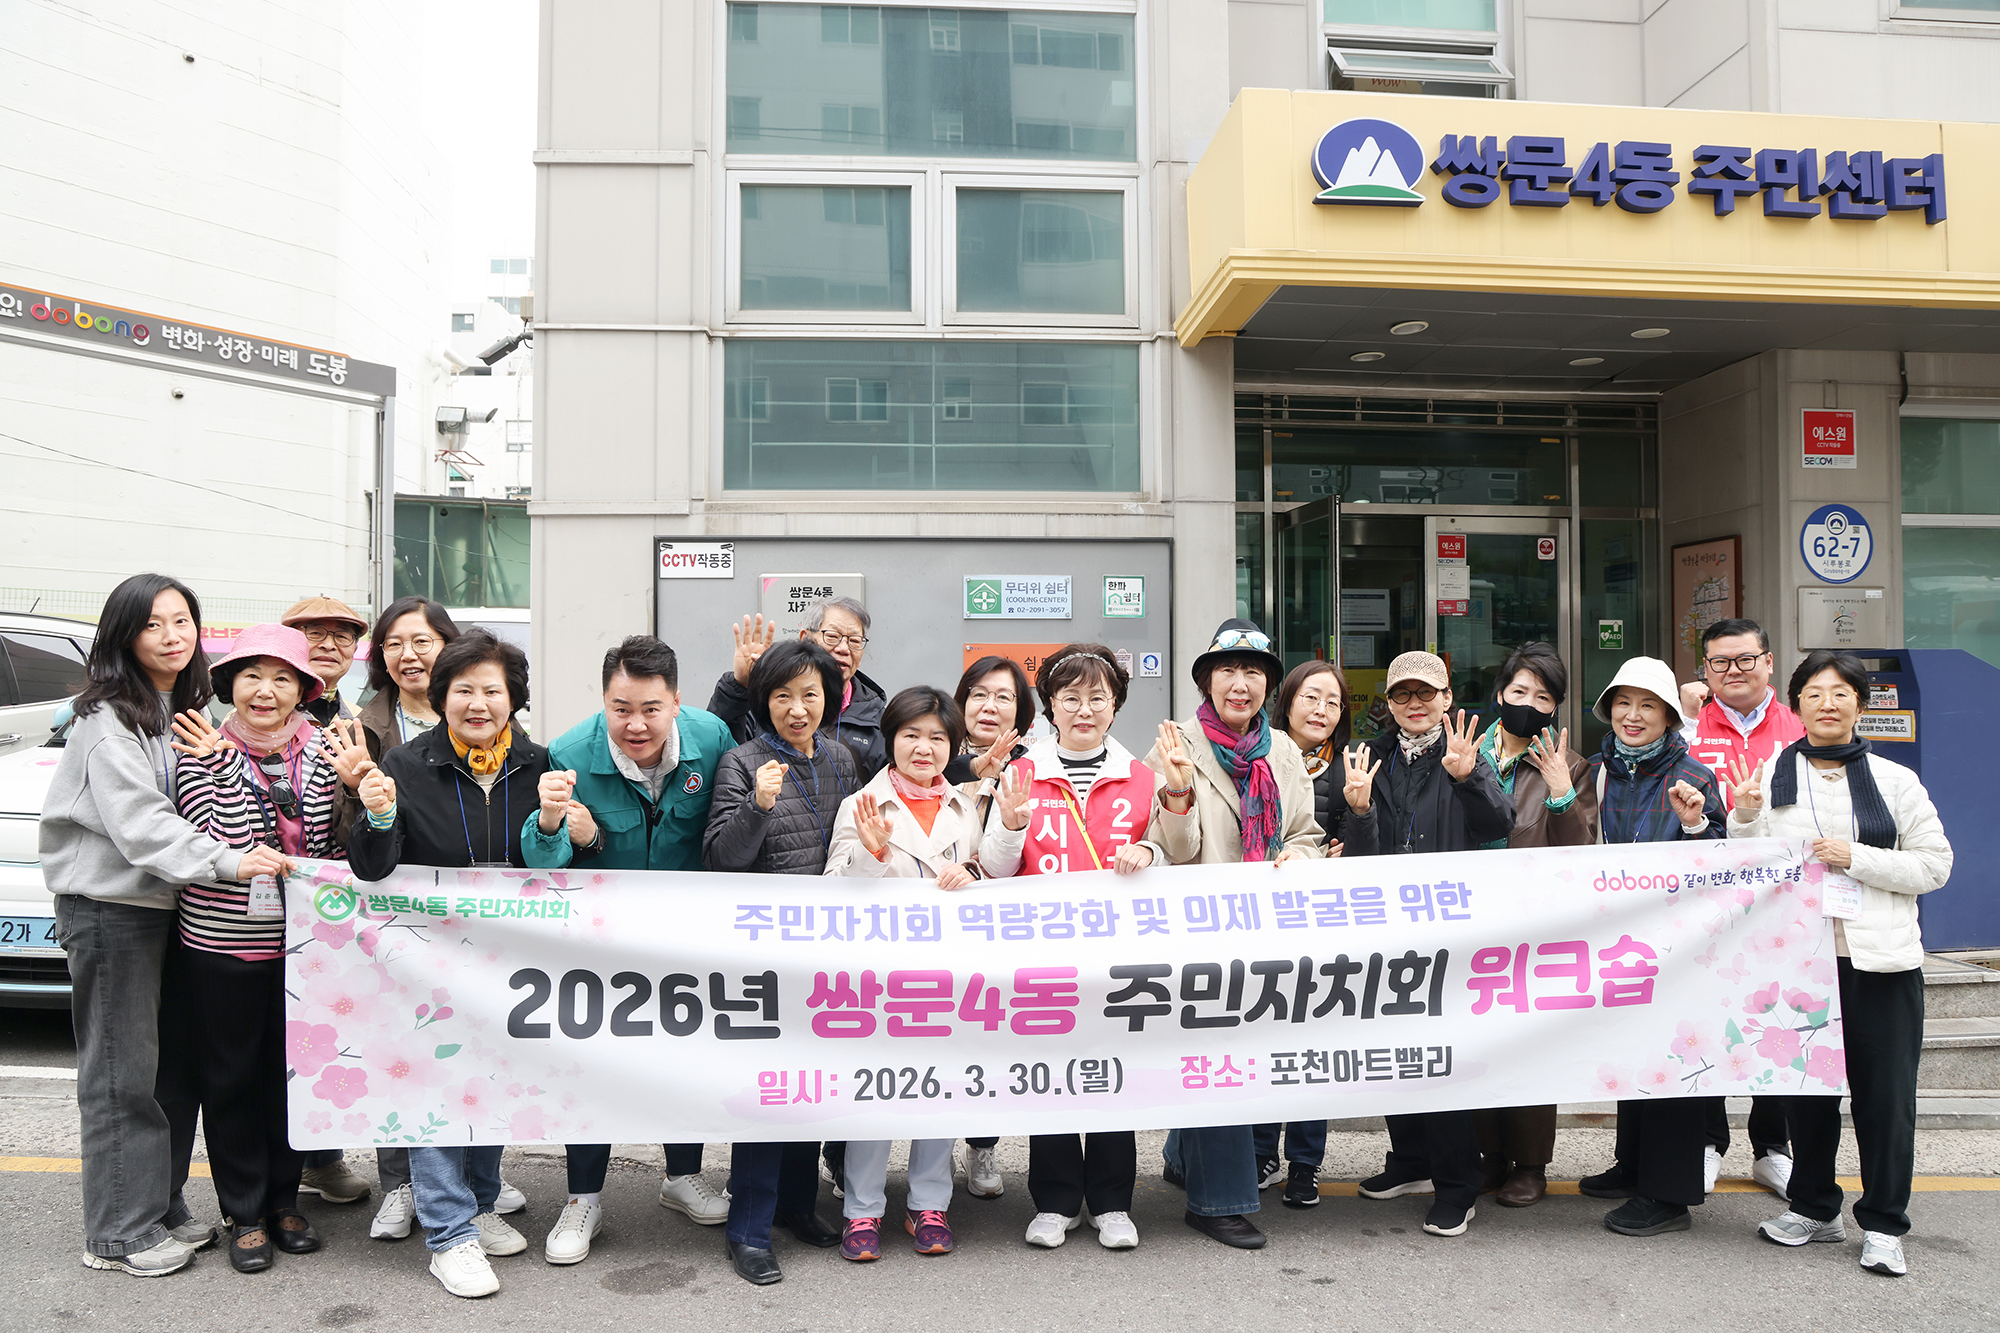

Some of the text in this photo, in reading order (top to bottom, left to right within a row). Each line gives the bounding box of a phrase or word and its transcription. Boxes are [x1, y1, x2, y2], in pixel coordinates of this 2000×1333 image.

[1430, 133, 1947, 224] 쌍문4동 주민센터
[30, 296, 150, 347] dobong
[161, 324, 299, 371] 변화·성장·미래
[306, 352, 348, 386] 도봉
[1812, 426, 1847, 441] 에스원
[1804, 456, 1833, 466] SECOM
[1441, 542, 1461, 551] 에스원
[1814, 536, 1860, 558] 62-7
[1822, 560, 1852, 569] 시루봉로
[790, 586, 833, 598] 쌍문4동
[1005, 582, 1068, 595] 무더위 쉼터
[1108, 581, 1127, 591] 한파
[1006, 596, 1068, 604] (COOLING CENTER)
[1123, 592, 1141, 603] 쉼터
[1016, 606, 1066, 614] 02-2091-3057
[1111, 798, 1133, 828] 2
[1593, 869, 1680, 894] dobong
[1684, 873, 1706, 889] 같이
[1740, 867, 1780, 885] 행복한
[1784, 865, 1802, 883] 도봉
[368, 894, 571, 919] 쌍문4동 주민자치회
[733, 880, 1473, 942] 주민자치회 역량강화 및 의제 발굴을 위한
[507, 933, 1660, 1040] 2026년 쌍문4동 주민자치회 워크숍
[757, 1045, 1453, 1106] 일시: 2026. 3. 30.(월) 장소: 포천아트밸리
